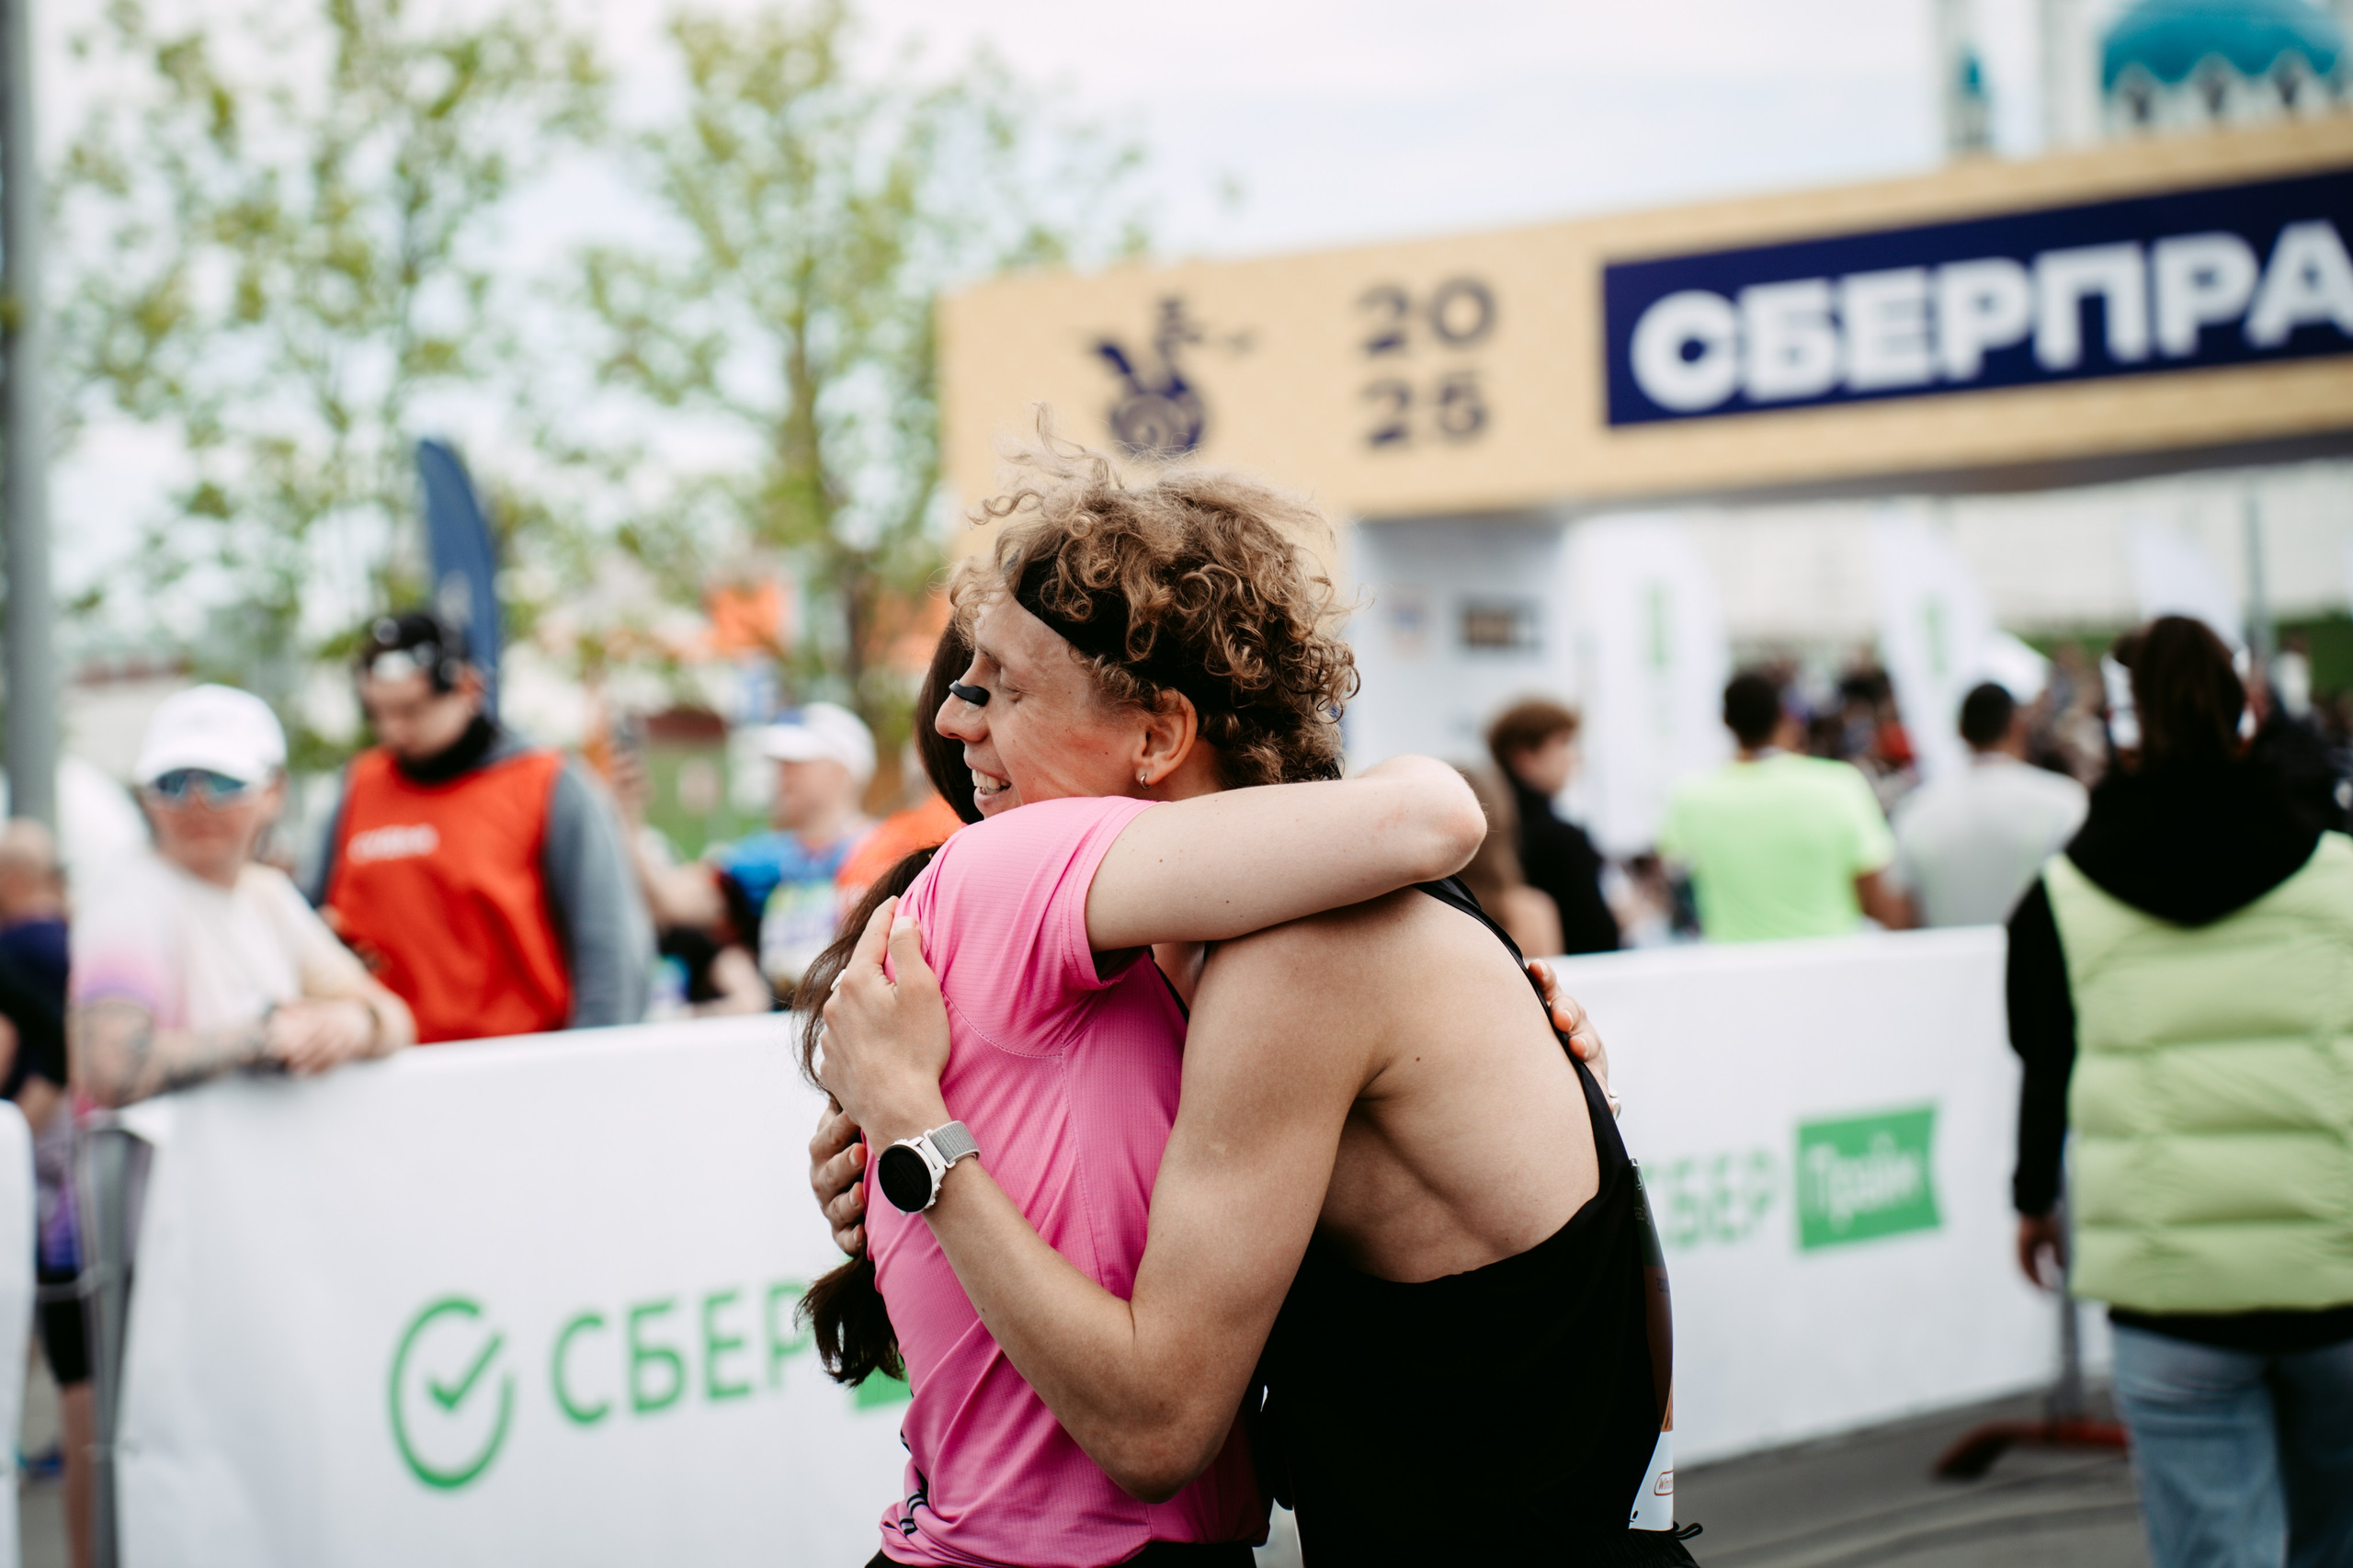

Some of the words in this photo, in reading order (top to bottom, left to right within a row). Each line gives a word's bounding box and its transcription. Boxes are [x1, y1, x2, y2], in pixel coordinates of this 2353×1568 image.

[1355, 278, 1499, 355] 20
[1630, 219, 2353, 413] СБЕРПРА
[1359, 369, 1491, 449] 25
[550, 1278, 816, 1428] СБЕР
